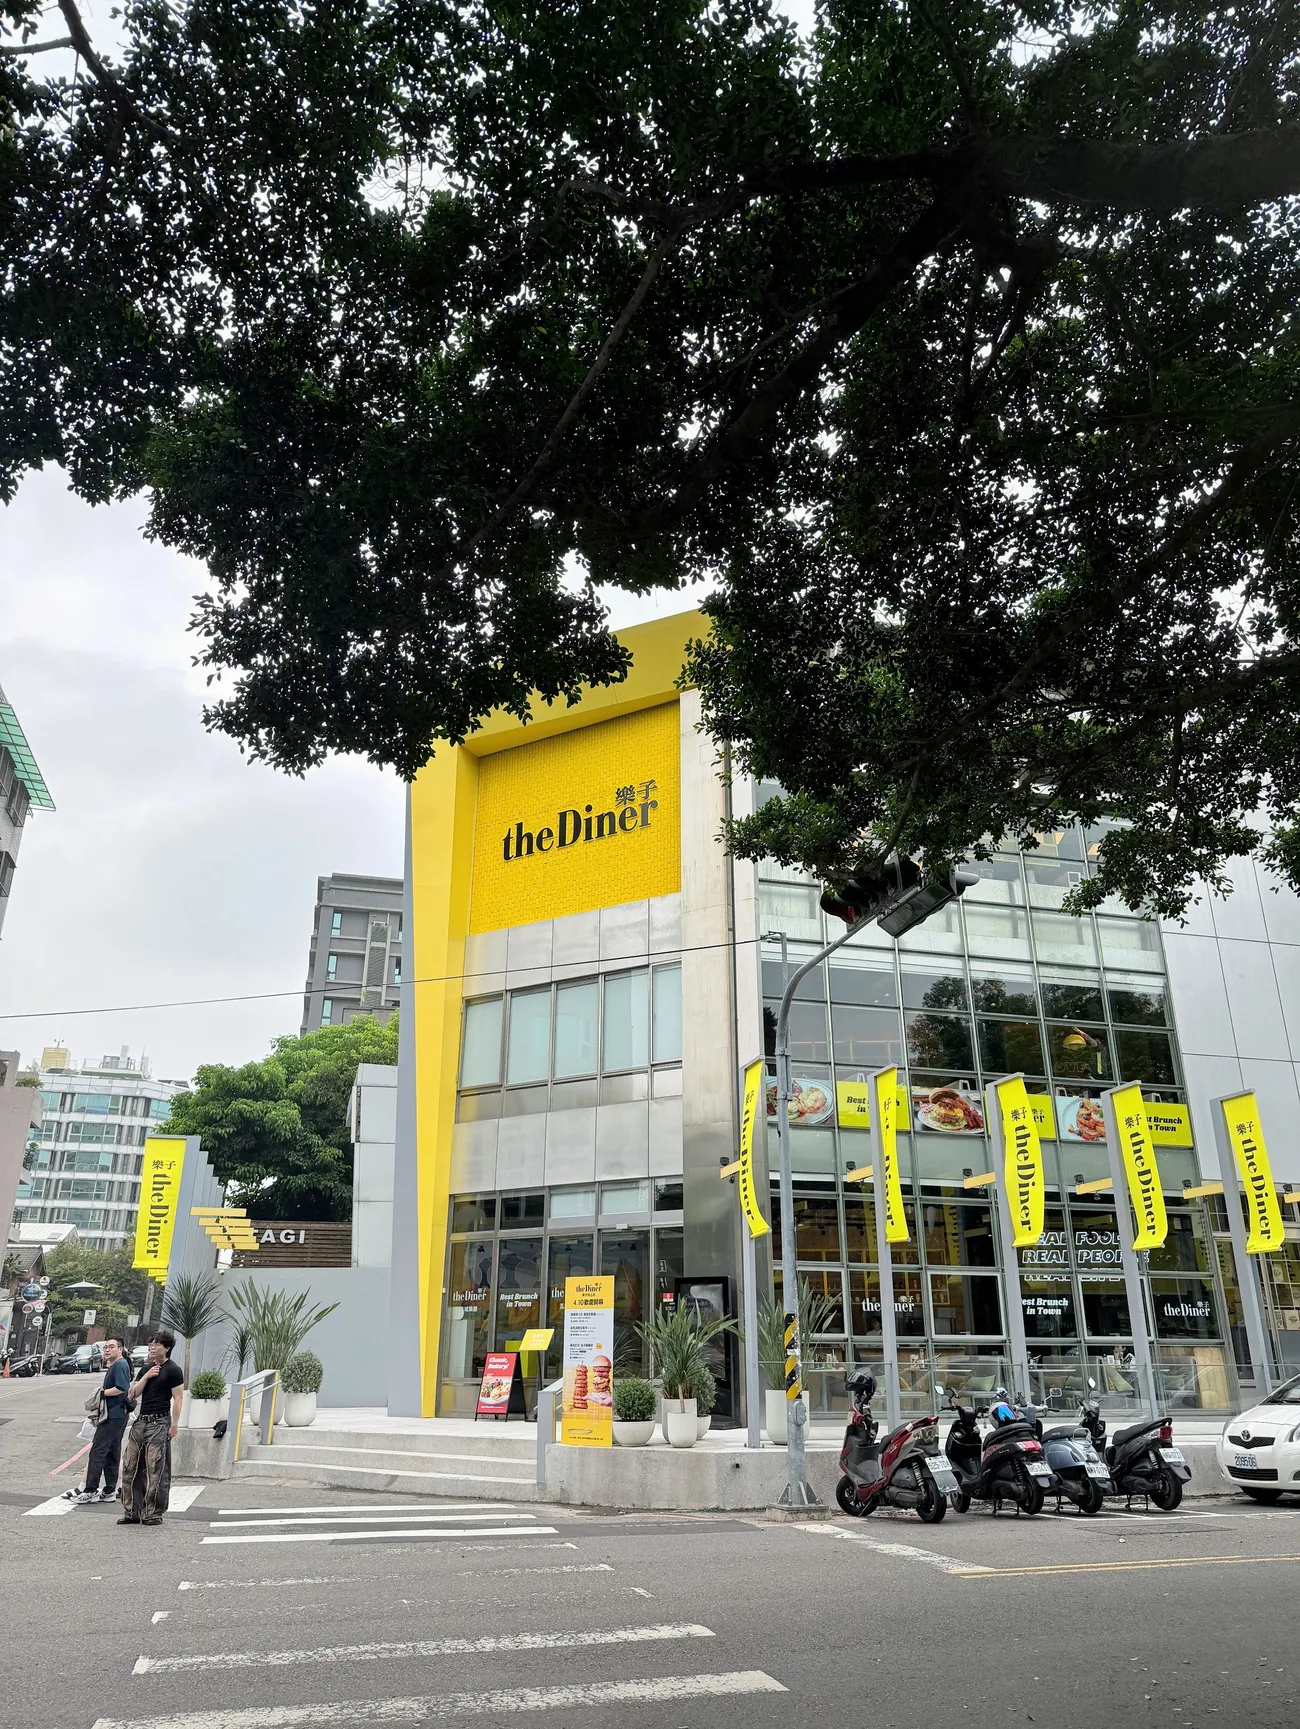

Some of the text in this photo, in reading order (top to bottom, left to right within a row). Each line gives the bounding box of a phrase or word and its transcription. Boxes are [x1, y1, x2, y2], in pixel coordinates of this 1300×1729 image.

[615, 779, 658, 807] 樂子
[502, 799, 658, 861] theDiner
[846, 1096, 868, 1105] Best
[857, 1105, 866, 1113] in
[1011, 1106, 1027, 1122] 樂子
[1124, 1113, 1142, 1129] 樂子
[1153, 1116, 1182, 1125] Brunch
[1154, 1124, 1177, 1132] Town
[1235, 1121, 1255, 1136] 樂子
[152, 1160, 176, 1170] 樂子
[1014, 1124, 1036, 1231] theDiner
[1129, 1131, 1156, 1236] theDiner
[1241, 1138, 1271, 1240] theDiner
[146, 1173, 172, 1259] theDiner
[253, 1229, 306, 1244] AGI
[453, 1290, 486, 1301] theDiner
[575, 1284, 602, 1293] theDiner
[514, 1292, 538, 1300] Brunch
[1036, 1298, 1068, 1306] Brunch
[862, 1297, 914, 1312] thener
[1026, 1306, 1062, 1315] in Town
[1164, 1303, 1210, 1317] theDiner
